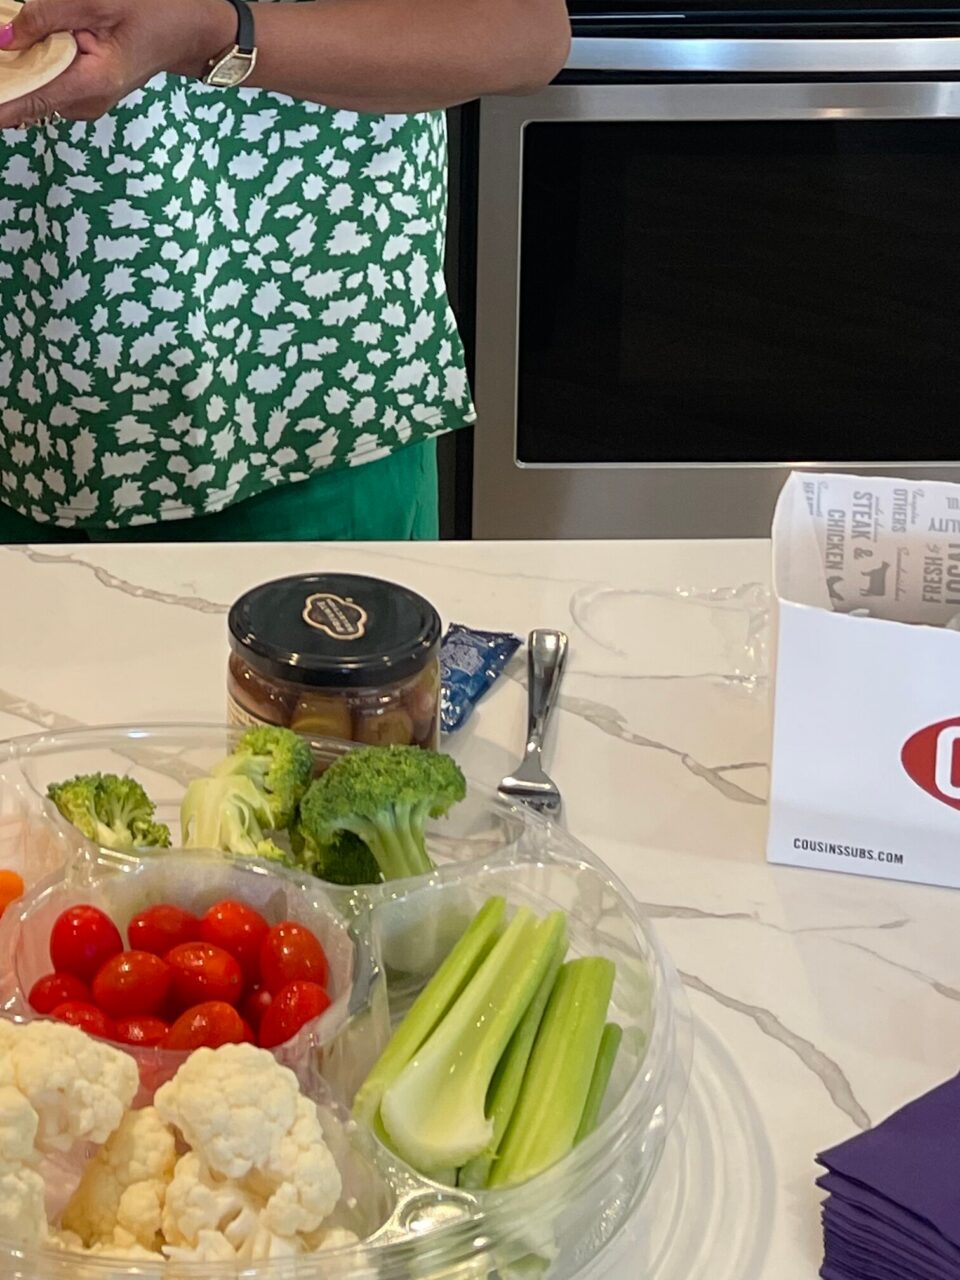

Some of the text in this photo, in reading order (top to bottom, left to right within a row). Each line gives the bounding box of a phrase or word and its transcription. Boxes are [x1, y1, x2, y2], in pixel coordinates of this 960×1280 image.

[851, 490, 874, 561] STEAK &
[891, 488, 909, 534] OTHERS
[825, 508, 846, 571] CHICKEN
[922, 555, 943, 604] FRESH
[793, 837, 904, 864] COUSINSSUBS.COM
